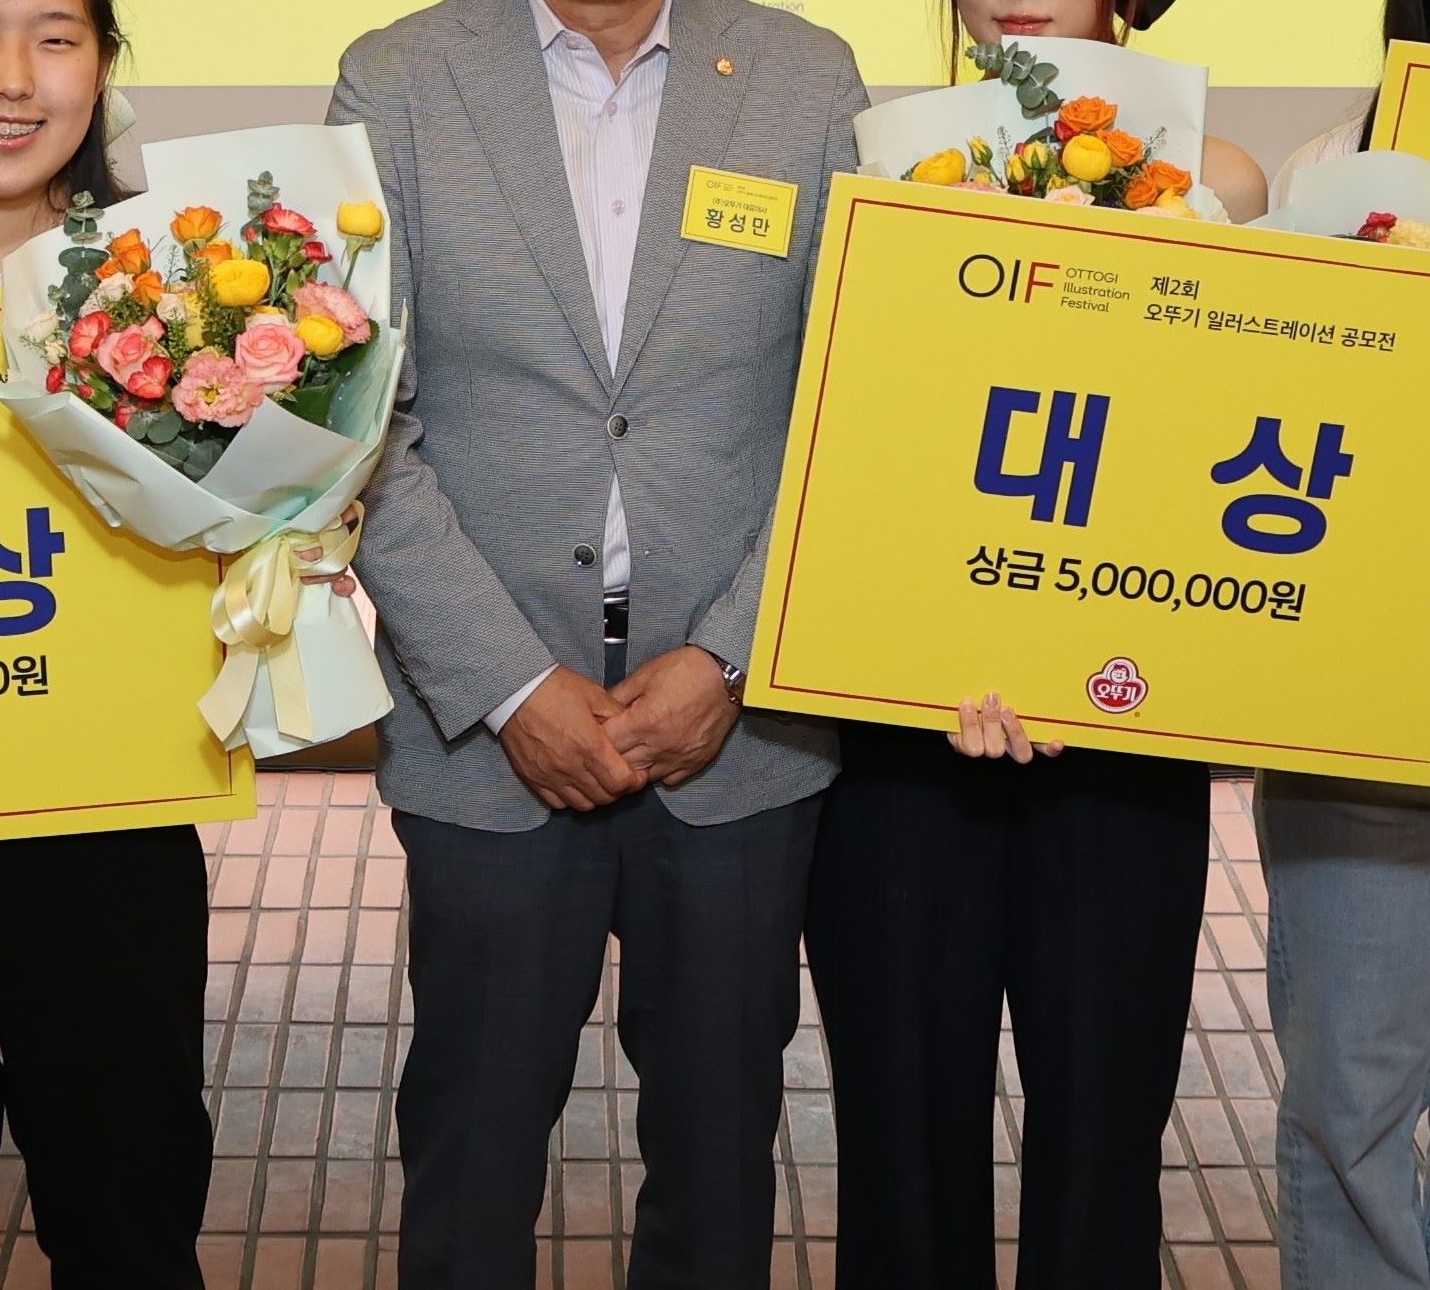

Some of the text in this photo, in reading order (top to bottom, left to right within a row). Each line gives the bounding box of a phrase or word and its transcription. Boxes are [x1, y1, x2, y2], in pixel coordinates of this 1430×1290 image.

[959, 254, 1060, 303] OIF
[1066, 268, 1118, 284] OTTOGI
[1150, 276, 1200, 300] 제2회
[1060, 282, 1130, 306] Illustration
[1060, 296, 1109, 313] Festival
[1144, 304, 1396, 352] 오뚜기 일러스트레이션 공모전
[966, 546, 1306, 621] 상금 5,000,000원
[1095, 681, 1138, 704] 오뚜기
